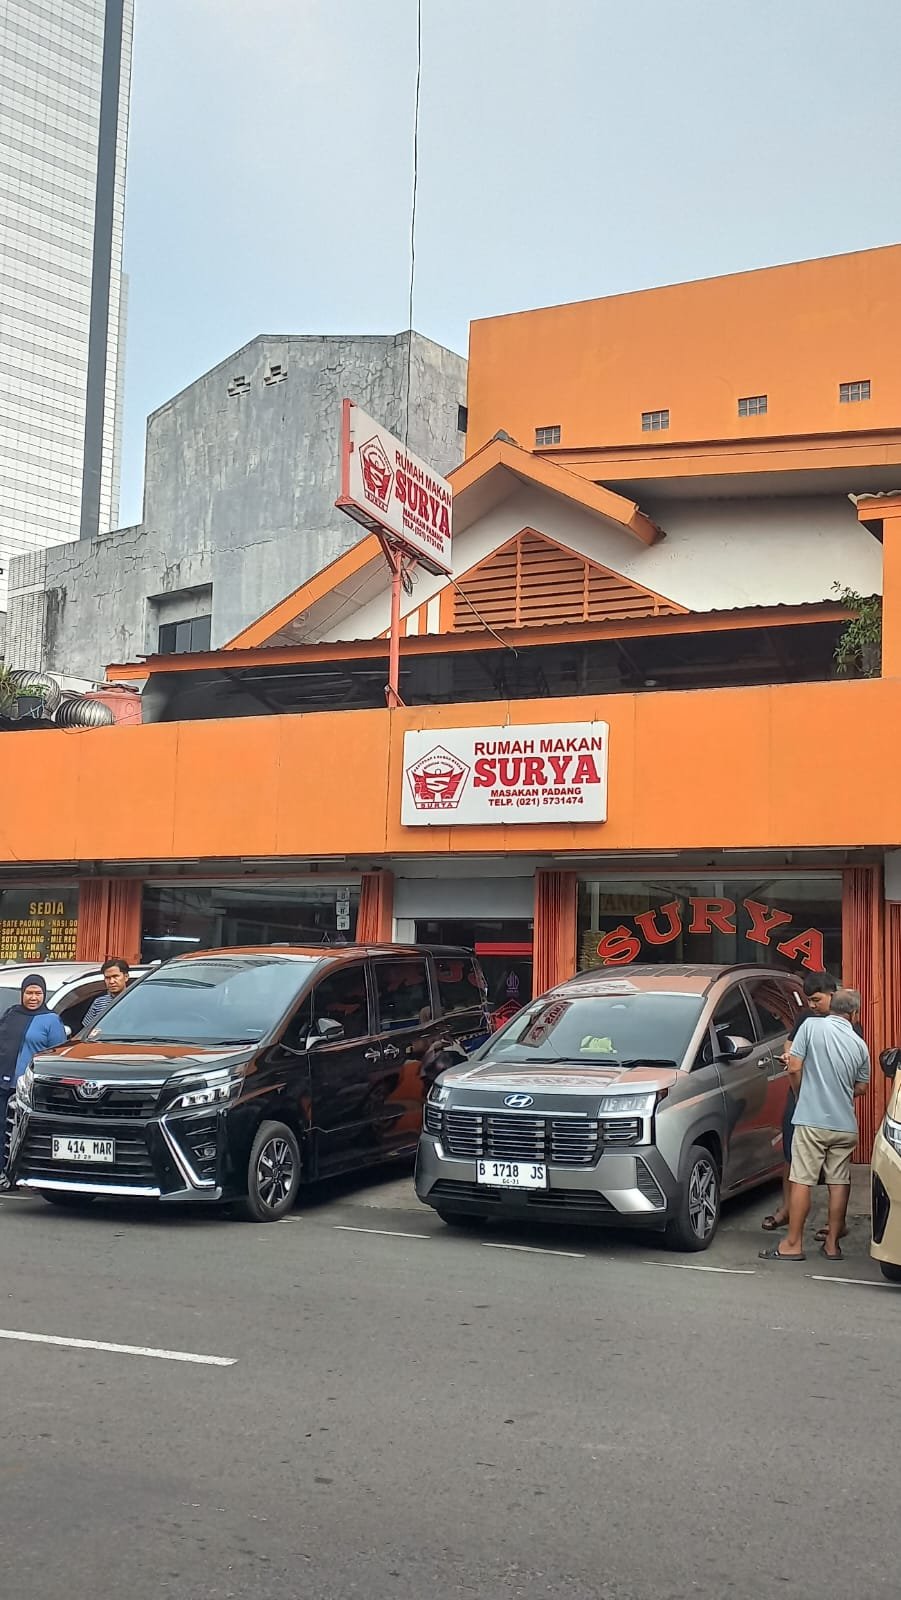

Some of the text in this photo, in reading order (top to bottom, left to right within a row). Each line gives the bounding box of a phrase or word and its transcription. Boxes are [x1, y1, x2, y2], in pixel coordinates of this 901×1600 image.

[395, 450, 424, 485] RUMAH
[425, 474, 452, 508] MAKAN
[395, 469, 451, 539] SURYA
[426, 523, 443, 544] PADANG
[474, 737, 602, 756] RUMAH MAKAN
[473, 754, 601, 788] SURYA
[490, 787, 582, 797] MASAKAN PADANG
[488, 796, 584, 808] TELP. (021) 5731474
[29, 901, 65, 915] SEDIA
[52, 919, 67, 927] NASI
[19, 935, 45, 943] PADANG
[596, 896, 827, 973] SURYA
[0, 943, 36, 951] SOTO AYAM
[49, 951, 67, 960] AYAM
[54, 1139, 112, 1155] B 414 MAR
[479, 1163, 544, 1180] B 1718 JS
